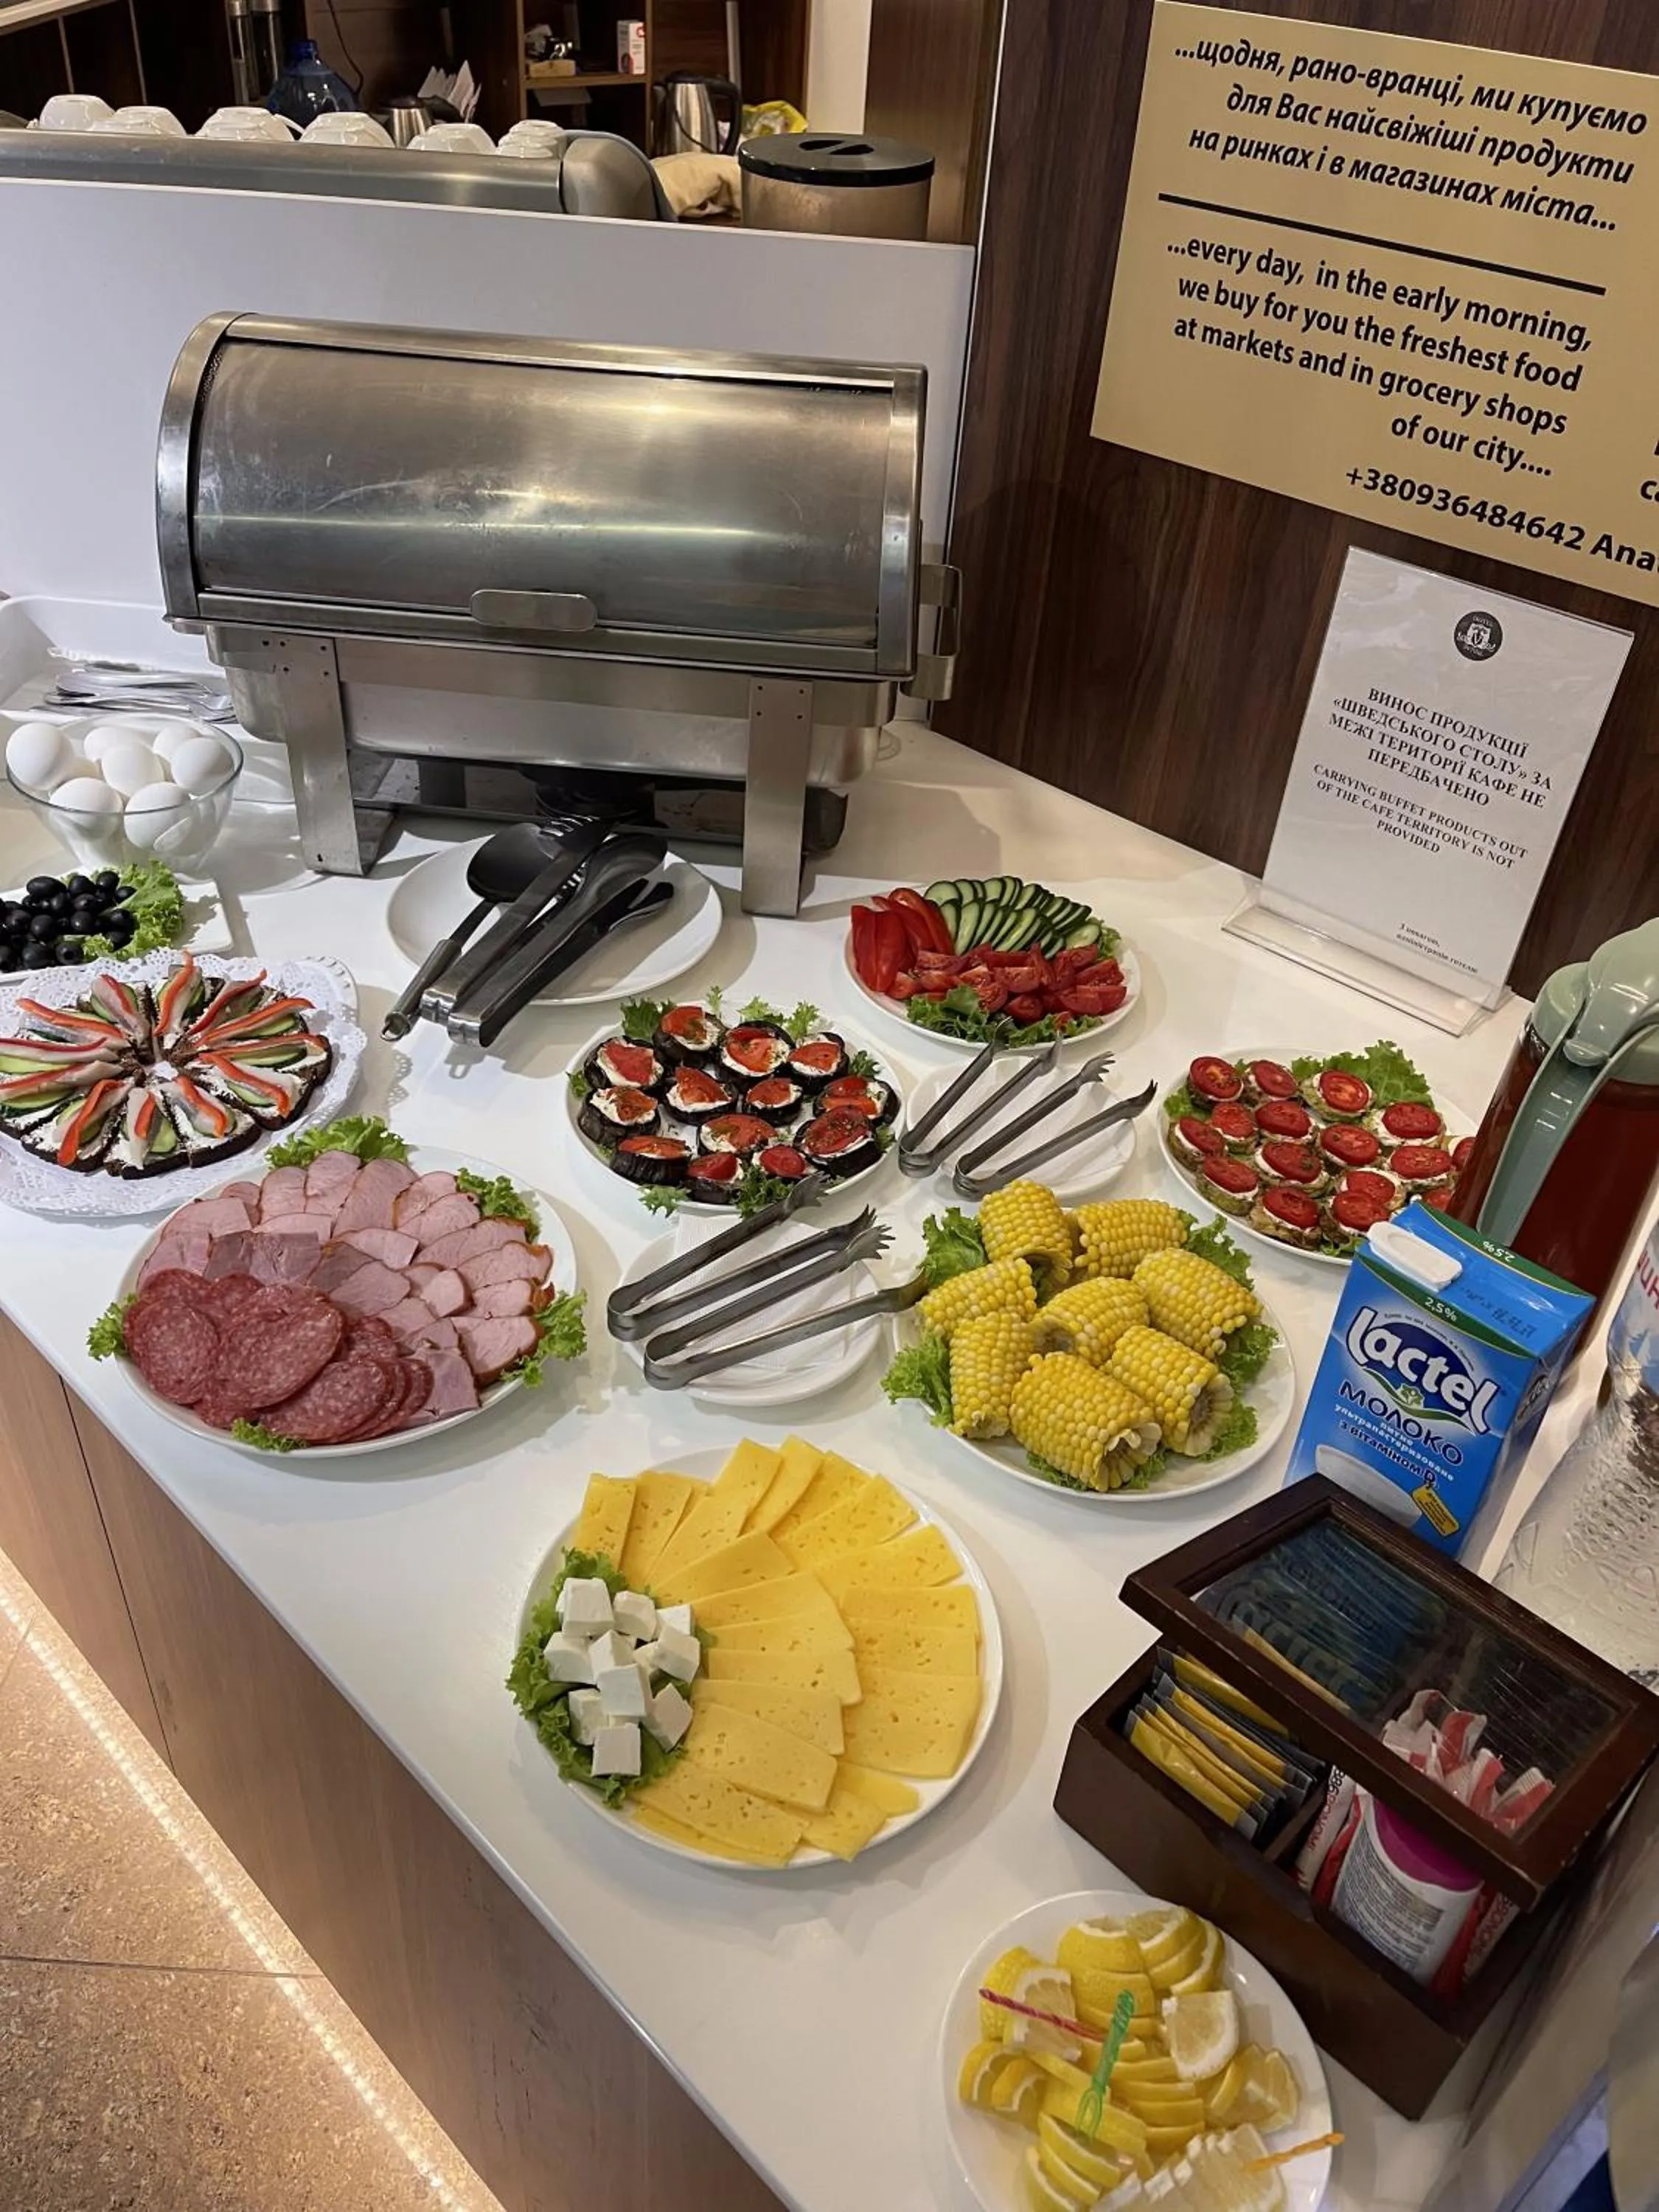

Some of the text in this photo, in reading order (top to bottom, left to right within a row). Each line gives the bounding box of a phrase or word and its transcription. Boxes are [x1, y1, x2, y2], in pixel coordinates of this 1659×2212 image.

[1227, 83, 1634, 183] для Вас найсвіжіші продукти
[1289, 56, 1464, 106] рано-вранці,
[1470, 86, 1514, 111] ми
[1517, 94, 1646, 134] купуємо
[1189, 130, 1220, 151] на
[1221, 136, 1314, 169] ринках
[1315, 146, 1328, 171] і
[1329, 156, 1345, 175] в
[1348, 159, 1500, 205] магазинах
[1180, 278, 1583, 391] we buy for you the freshest food
[1256, 248, 1304, 285] day,
[1316, 260, 1339, 289] in
[1346, 268, 1386, 299] the
[1393, 286, 1460, 322] early
[1464, 301, 1591, 352] morning,
[1175, 319, 1568, 435] at markets and in grocery shops
[1392, 415, 1422, 439] of
[1423, 427, 1469, 452] our
[1346, 468, 1659, 573] +380936484642 Ana
[1329, 712, 1546, 809] МЕЖІ ТЕРИТОРІЇ КАФЕ НЕ
[1368, 687, 1529, 759] ВИНОС ПРОДУКЦІЇ
[1313, 764, 1528, 858] CARRYING BUFFET PRODUCTS OUT
[1368, 748, 1489, 806] ПЕРЕДБАЧЕНО
[1531, 771, 1551, 791] ЗА
[1316, 779, 1515, 869] OF THE CAFE TERRITORY IS NOT
[1377, 819, 1440, 853] PROVIDED
[1425, 1296, 1457, 1322] 2,5%
[1339, 1380, 1464, 1466] МОЛОКО
